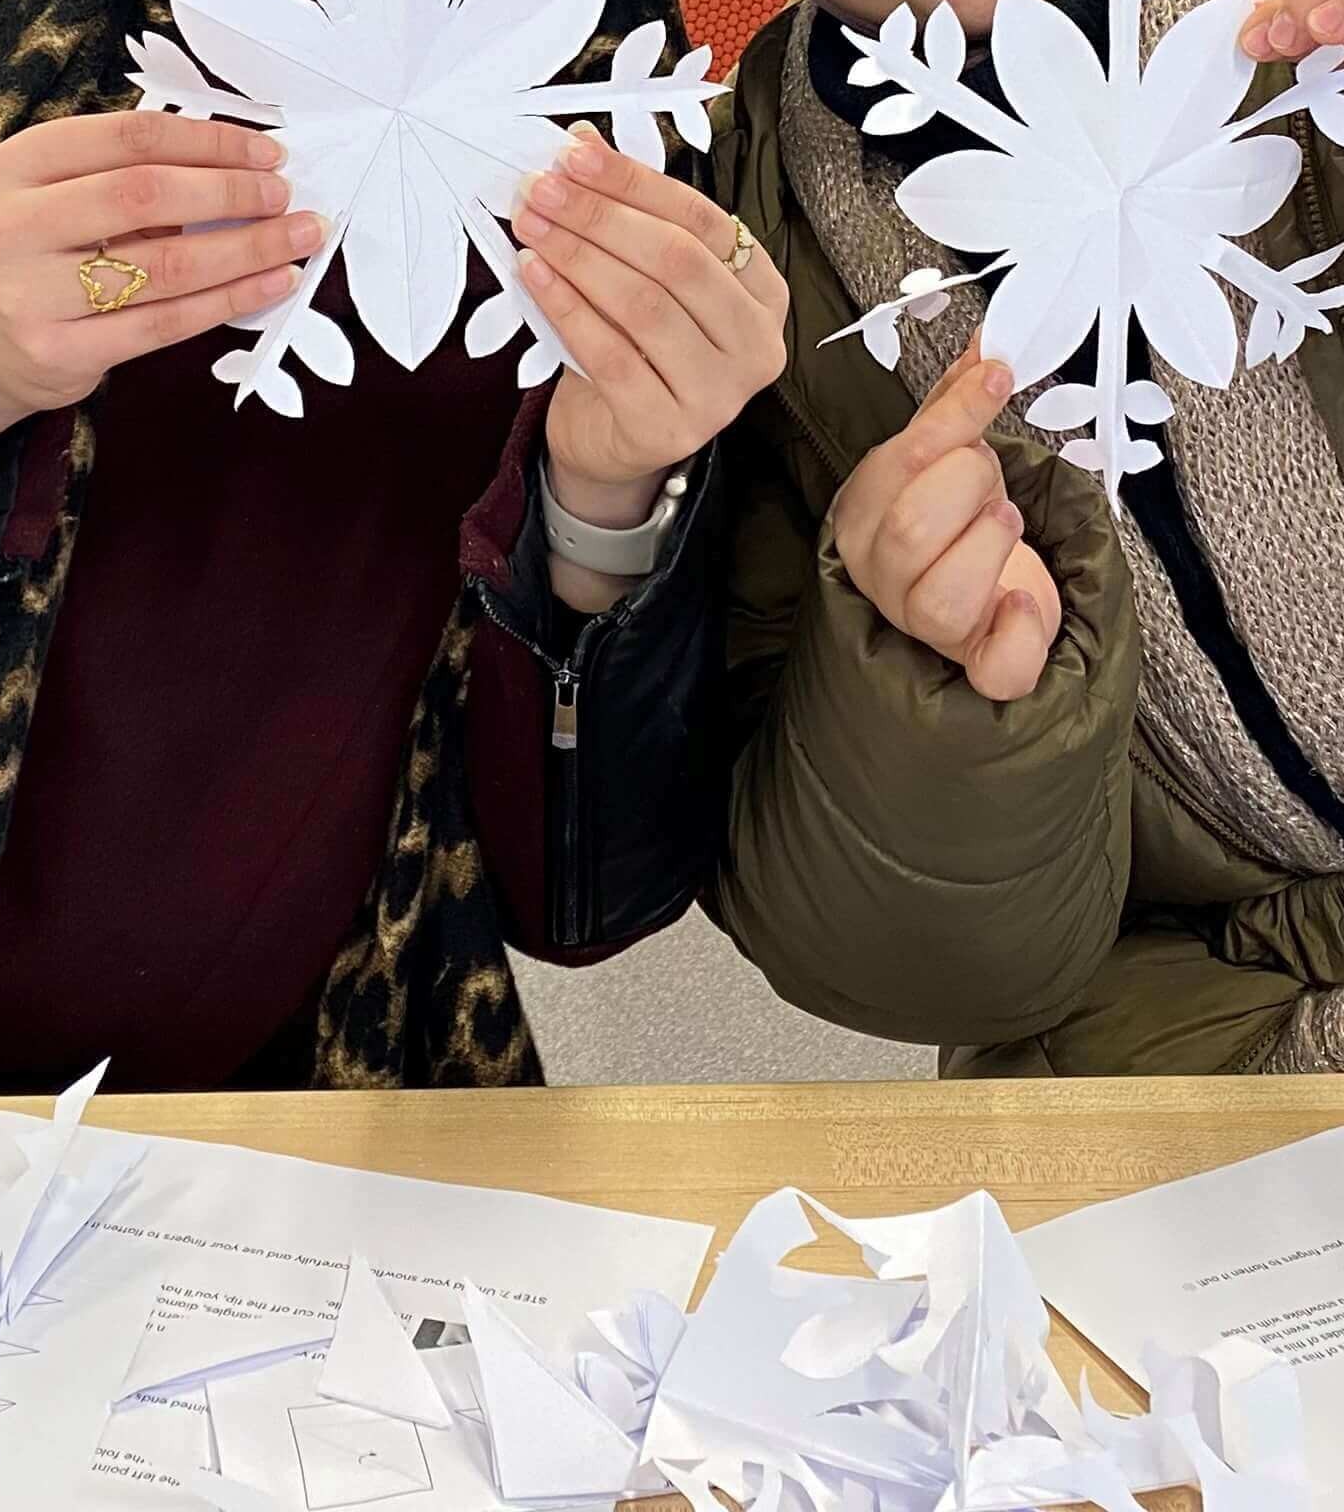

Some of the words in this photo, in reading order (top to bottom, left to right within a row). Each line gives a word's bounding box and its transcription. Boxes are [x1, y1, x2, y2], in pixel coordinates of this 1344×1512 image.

[103, 1223, 144, 1237] flatten
[147, 1231, 160, 1239] to
[163, 1233, 207, 1248] fingers
[209, 1241, 239, 1252] your
[241, 1246, 265, 1256] use
[265, 1251, 292, 1261] and
[1281, 1248, 1321, 1263] fingers
[295, 1255, 351, 1271] carefully
[1230, 1263, 1269, 1277] flatten
[422, 1277, 450, 1287] your
[1220, 1272, 1232, 1281] it
[183, 1289, 219, 1301] you'll
[452, 1281, 496, 1297] Unld
[499, 1289, 511, 1299] 7:
[224, 1294, 243, 1306] tip,
[246, 1300, 268, 1310] the
[513, 1293, 548, 1305] STEP
[269, 1305, 291, 1313] off
[292, 1308, 315, 1317] cut
[1282, 1301, 1338, 1320] snowflake
[1245, 1323, 1257, 1331] a
[1255, 1317, 1282, 1328] with
[1281, 1323, 1311, 1336] even
[1259, 1331, 1284, 1344] half
[1306, 1336, 1320, 1347] of
[1284, 1340, 1307, 1352] this
[1324, 1347, 1339, 1357] of
[1301, 1351, 1326, 1362] this
[135, 1391, 168, 1404] ends
[91, 1463, 130, 1476] point
[131, 1470, 156, 1483] left
